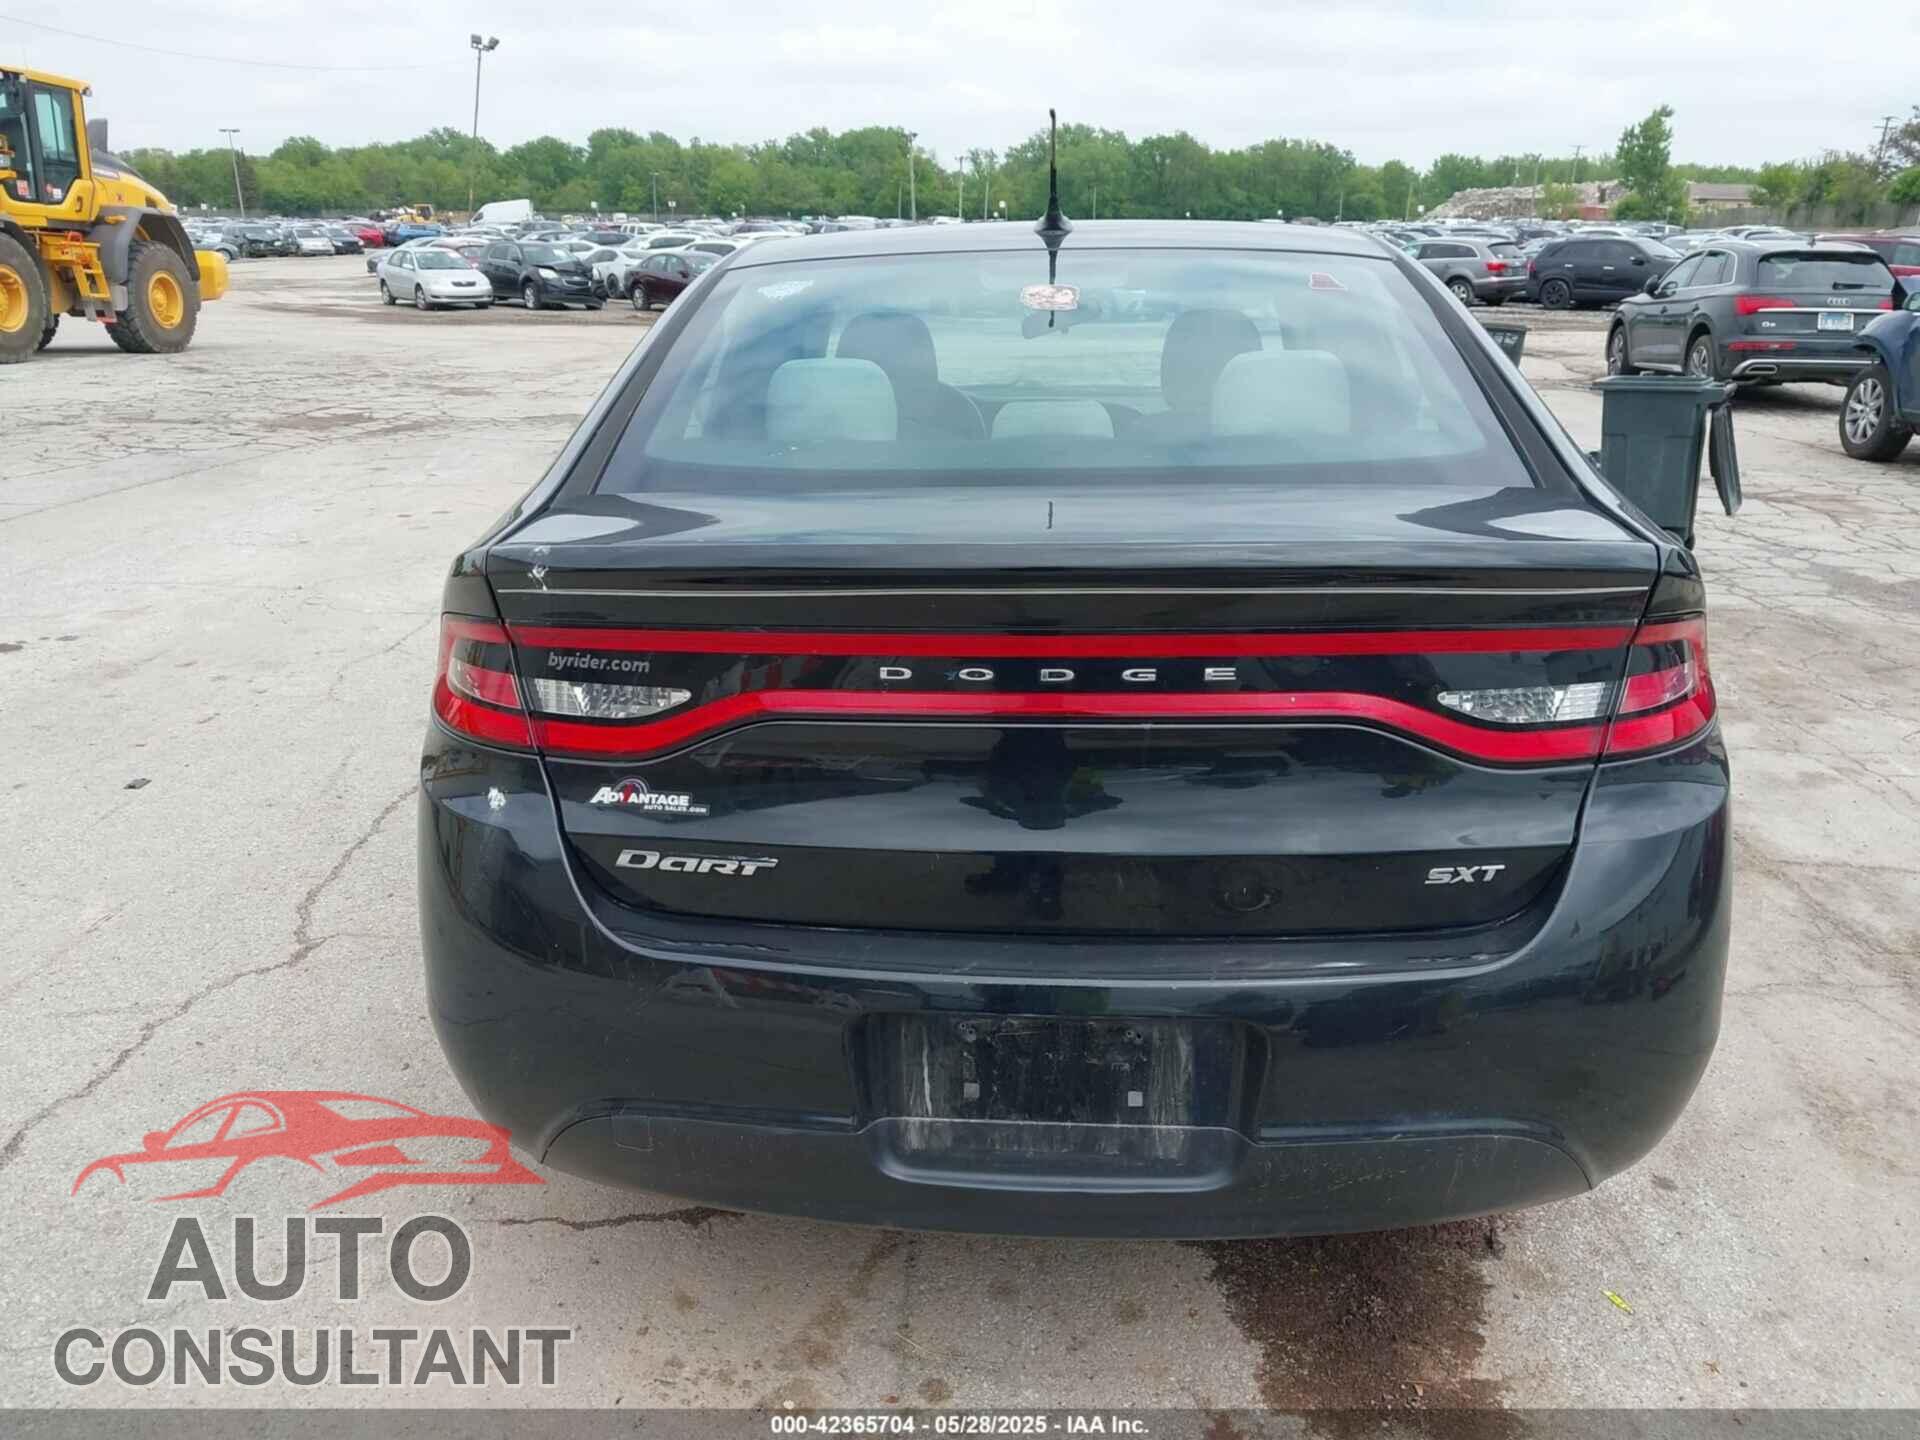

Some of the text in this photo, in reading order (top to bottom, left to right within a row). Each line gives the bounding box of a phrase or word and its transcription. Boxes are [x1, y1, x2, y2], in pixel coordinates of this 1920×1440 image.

[548, 652, 650, 673] byrider.com
[879, 666, 1237, 682] DODGE
[590, 783, 690, 806] ADVANTAGE
[1424, 864, 1506, 885] SXT
